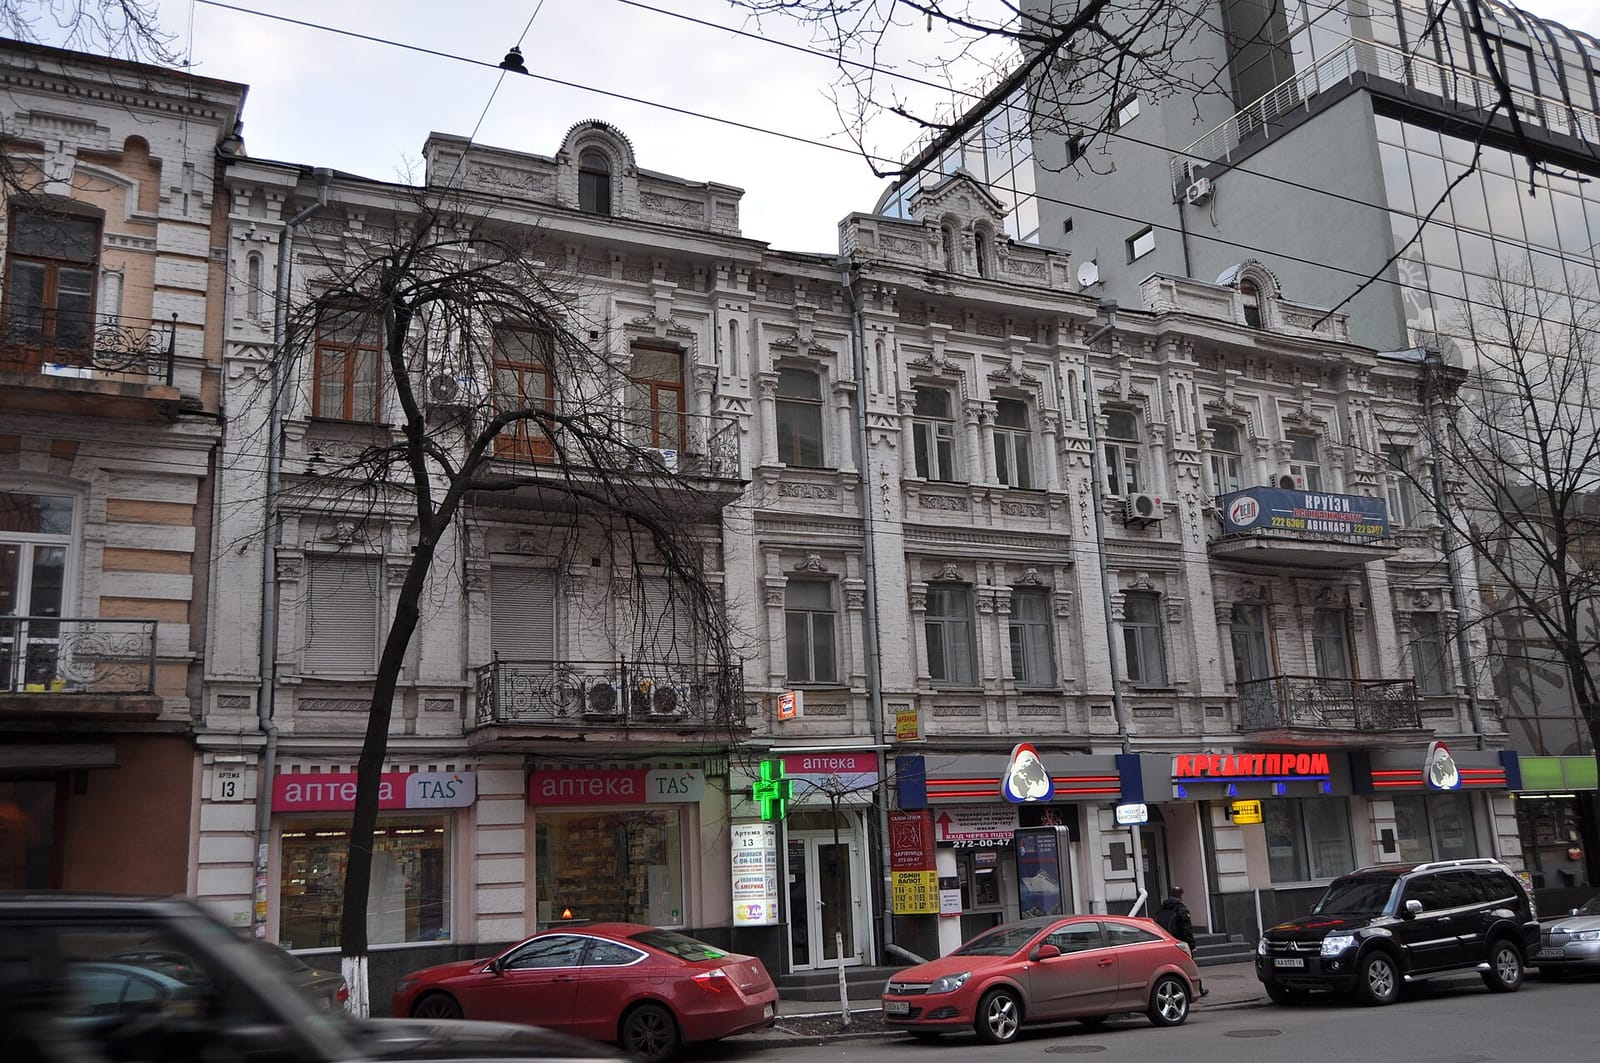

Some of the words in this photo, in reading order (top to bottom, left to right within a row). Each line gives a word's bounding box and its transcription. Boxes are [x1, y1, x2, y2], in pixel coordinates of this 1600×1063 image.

[1305, 495, 1350, 513] КРУЇЗИ
[1271, 516, 1285, 526] 222
[1307, 519, 1350, 532] АВІАКАСИ
[803, 758, 855, 769] аптека
[1174, 753, 1330, 777] КРЕДИТПРОМ
[221, 781, 235, 797] 13
[284, 782, 393, 802] аптеа
[418, 780, 457, 799] TAS
[542, 777, 634, 796] аптека
[655, 776, 690, 794] TAS
[734, 830, 761, 838] Артема
[743, 839, 754, 847] 13
[952, 839, 1010, 848] 272-00-47
